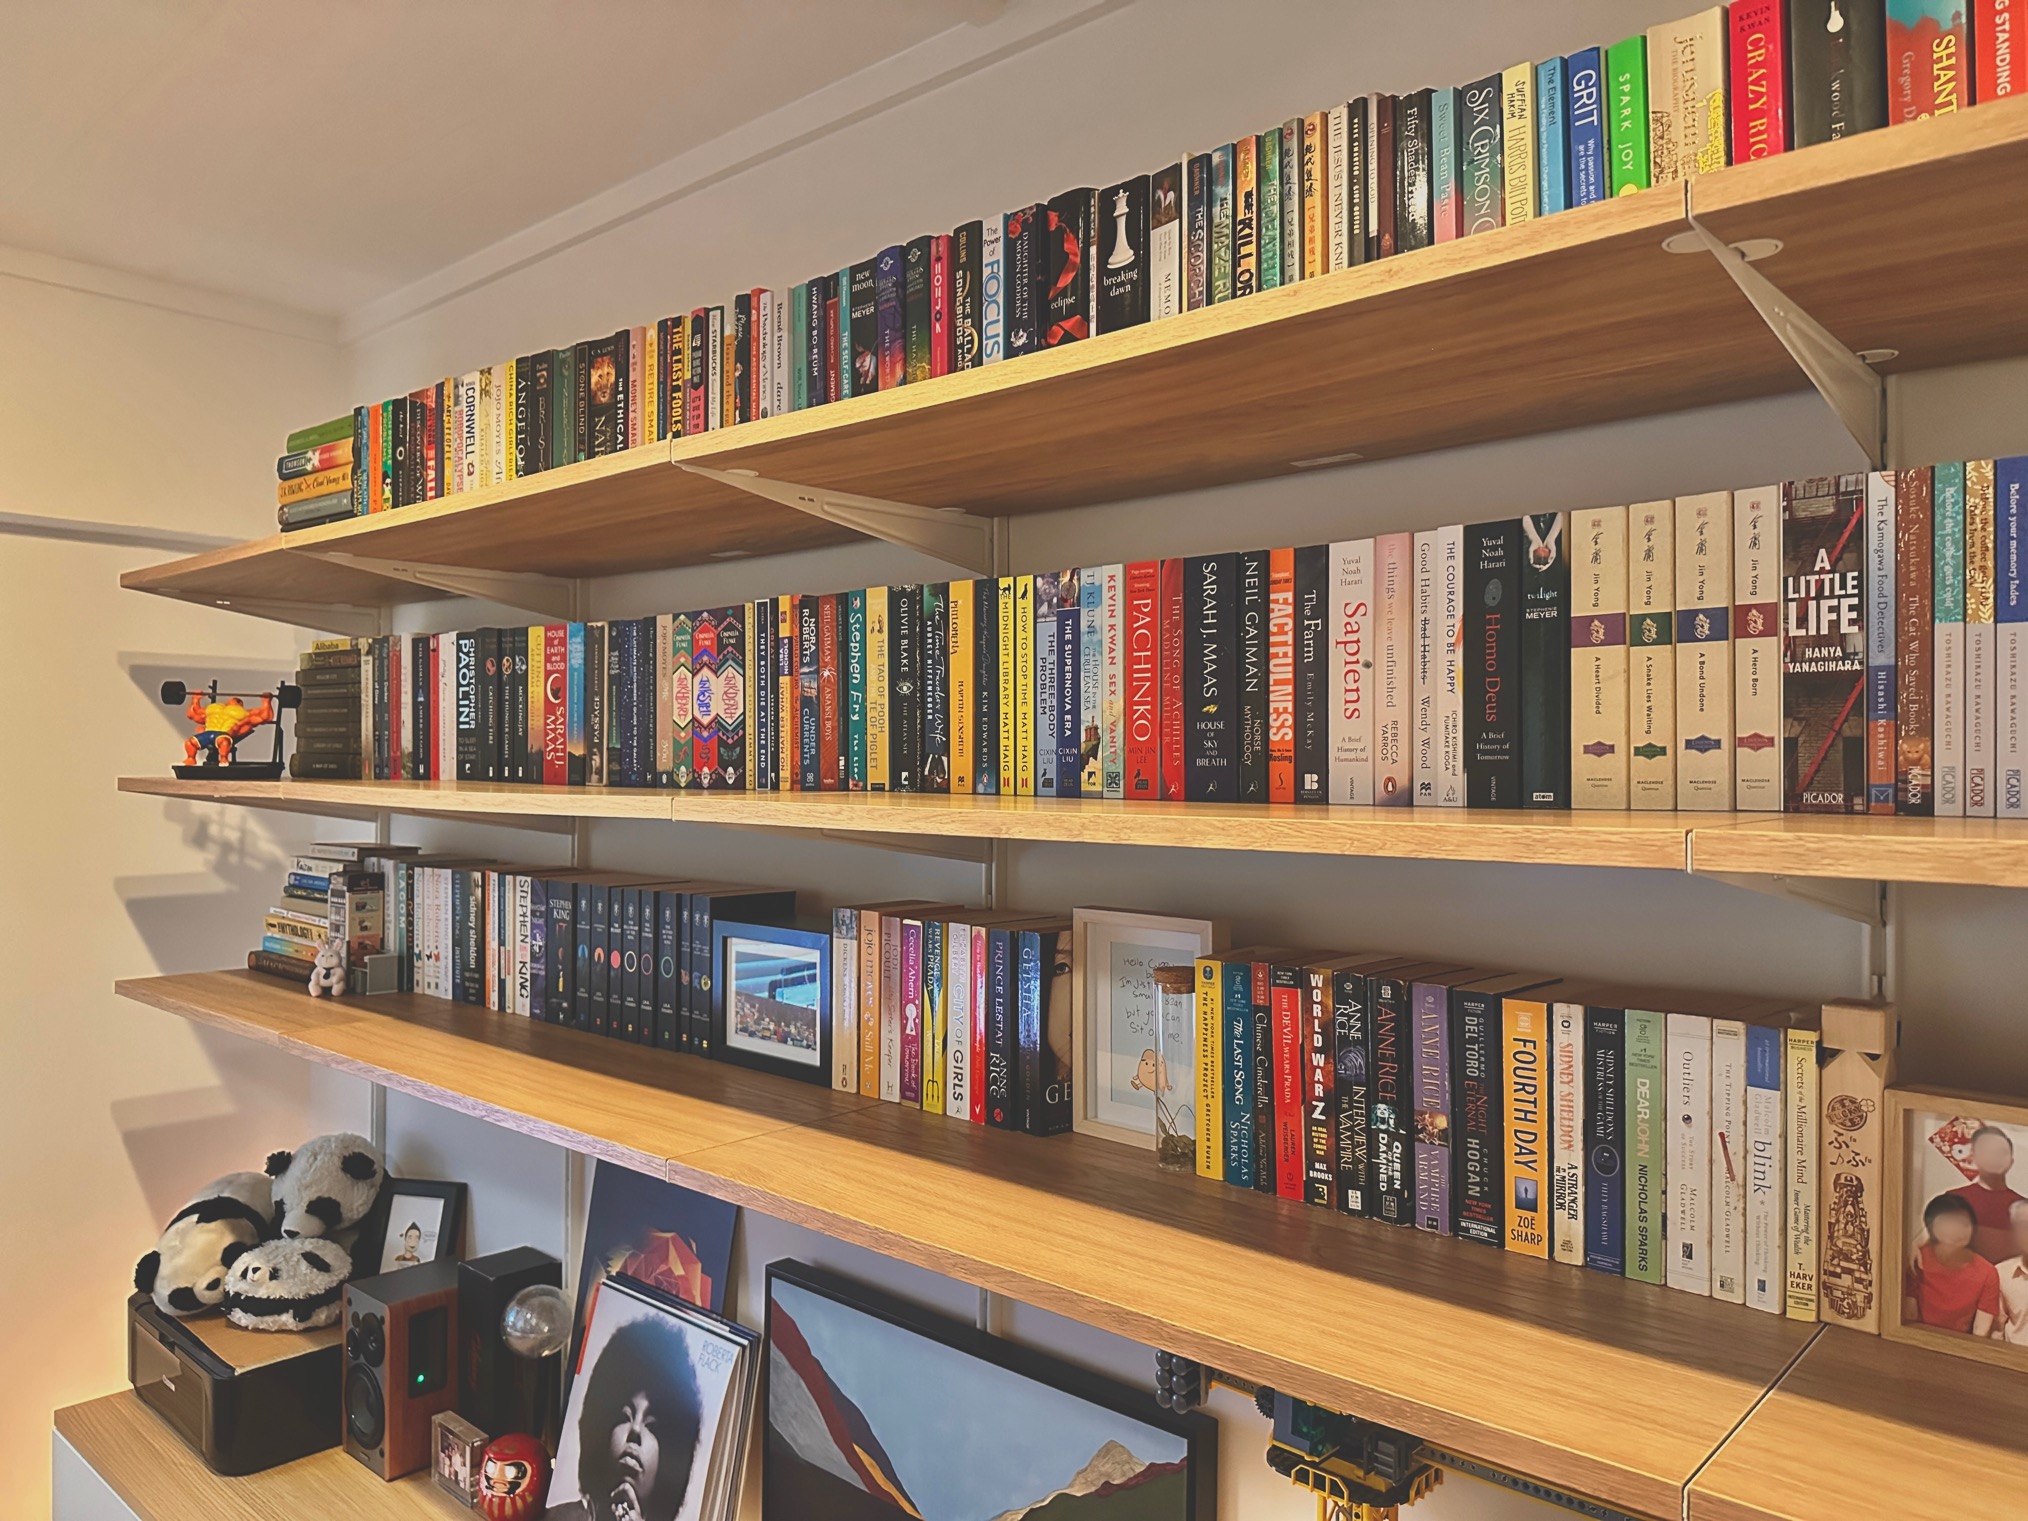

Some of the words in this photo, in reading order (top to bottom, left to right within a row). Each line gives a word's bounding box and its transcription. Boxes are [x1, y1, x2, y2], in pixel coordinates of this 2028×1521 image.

[1747, 33, 1768, 111] CRAZY
[1995, 14, 2011, 96] STANDING
[1547, 66, 1556, 87] The
[1466, 87, 1493, 126] SIX
[1547, 89, 1557, 126] Element
[1572, 69, 1598, 126] GRIT
[1618, 72, 1631, 132] SPARK
[1404, 107, 1417, 137] Fifty
[1438, 103, 1448, 144] Sweet
[1407, 139, 1419, 182] Shades
[1440, 148, 1450, 180] Bean
[1469, 125, 1495, 216] CRIMSON
[1618, 143, 1633, 171] JOY
[1440, 183, 1450, 217] Paste
[983, 236, 1001, 247] Power
[986, 228, 998, 236] The
[852, 279, 874, 292] moon
[856, 271, 871, 281] new
[1022, 283, 1028, 291] OF
[1104, 269, 1138, 286] breaking
[1109, 283, 1131, 298] dawn
[852, 307, 875, 319] MEYER
[983, 259, 1003, 359] FOCUS
[1051, 295, 1076, 315] eclipse
[673, 325, 683, 349] THE
[673, 353, 683, 386] LAST
[465, 386, 475, 459] CORNWELL
[672, 392, 682, 433] FOOLS
[1421, 543, 1430, 576] Good
[1446, 541, 1455, 564] THE
[1750, 559, 1758, 572] Jin
[1814, 548, 1831, 571] A
[1107, 574, 1116, 618] KEVIN
[1203, 562, 1217, 625] SARAH
[1246, 561, 1259, 605] NEIL
[1421, 579, 1430, 615] Habits
[1446, 566, 1455, 620] COURAGE
[1750, 574, 1758, 596] Yong
[1787, 571, 1859, 599] LITTLE
[900, 598, 908, 635] OLIVIE
[1304, 590, 1316, 616] The
[1788, 598, 1859, 637] LIFE
[547, 630, 564, 639] HOUSE
[850, 613, 863, 684] Stephen
[1021, 634, 1027, 651] TO
[1108, 624, 1116, 666] KWAN
[1200, 628, 1211, 638] J.
[1304, 618, 1321, 663] Farm
[1446, 623, 1455, 638] TO
[1446, 642, 1455, 655] BE
[1486, 613, 1500, 671] Homo
[546, 646, 565, 655] EARTH
[546, 661, 565, 671] BLOOD
[1246, 612, 1259, 691] GAIMAN
[1270, 591, 1293, 741] FACTFULNESS
[1335, 602, 1368, 720] Sapiens
[1788, 660, 1860, 673] YANAGIHARA
[1805, 646, 1843, 658] HANYA
[459, 640, 469, 729] PAOLINI
[1133, 599, 1152, 741] PACHINKO
[1203, 643, 1217, 697] MAAS
[1446, 658, 1455, 694] HAPPY
[851, 690, 862, 721] Fry
[1486, 677, 1500, 722] Deus
[556, 706, 564, 752] SARAH
[760, 712, 765, 724] AT
[1002, 712, 1010, 743] MATT
[1197, 721, 1225, 730] HOUSE
[546, 714, 556, 760] MAAS
[1109, 720, 1117, 766] VANITY
[1203, 739, 1219, 749] SKY
[1002, 744, 1010, 772] HAIG
[1196, 758, 1227, 767] BREATH
[1803, 793, 1844, 804] PICADOR
[519, 880, 529, 944] STEPHEN
[519, 961, 529, 999] KING
[952, 984, 964, 1025] CITY
[1336, 1005, 1348, 1036] RICE
[1349, 999, 1362, 1041] ANNE
[955, 1028, 963, 1046] OF
[953, 1050, 963, 1101] GIRLS
[1512, 1036, 1537, 1129] FOURTH
[1682, 1051, 1694, 1106] Outliers
[1312, 1101, 1326, 1120] Z
[1637, 1078, 1650, 1117] DEAR
[1230, 1121, 1238, 1167] SPARKS
[1240, 1111, 1249, 1181] NICHOLAS
[1514, 1133, 1538, 1172] DAY
[1637, 1116, 1650, 1158] JOHN
[1753, 1139, 1773, 1195] blink
[1637, 1164, 1648, 1215] NICHOLAS
[1510, 1228, 1543, 1246] SHARP
[1516, 1215, 1535, 1229] ZOË
[1637, 1218, 1648, 1272] SPARKS
[1789, 1271, 1814, 1282] HARV
[1790, 1281, 1813, 1291] EKER
[702, 1340, 733, 1364] ROBERTA
